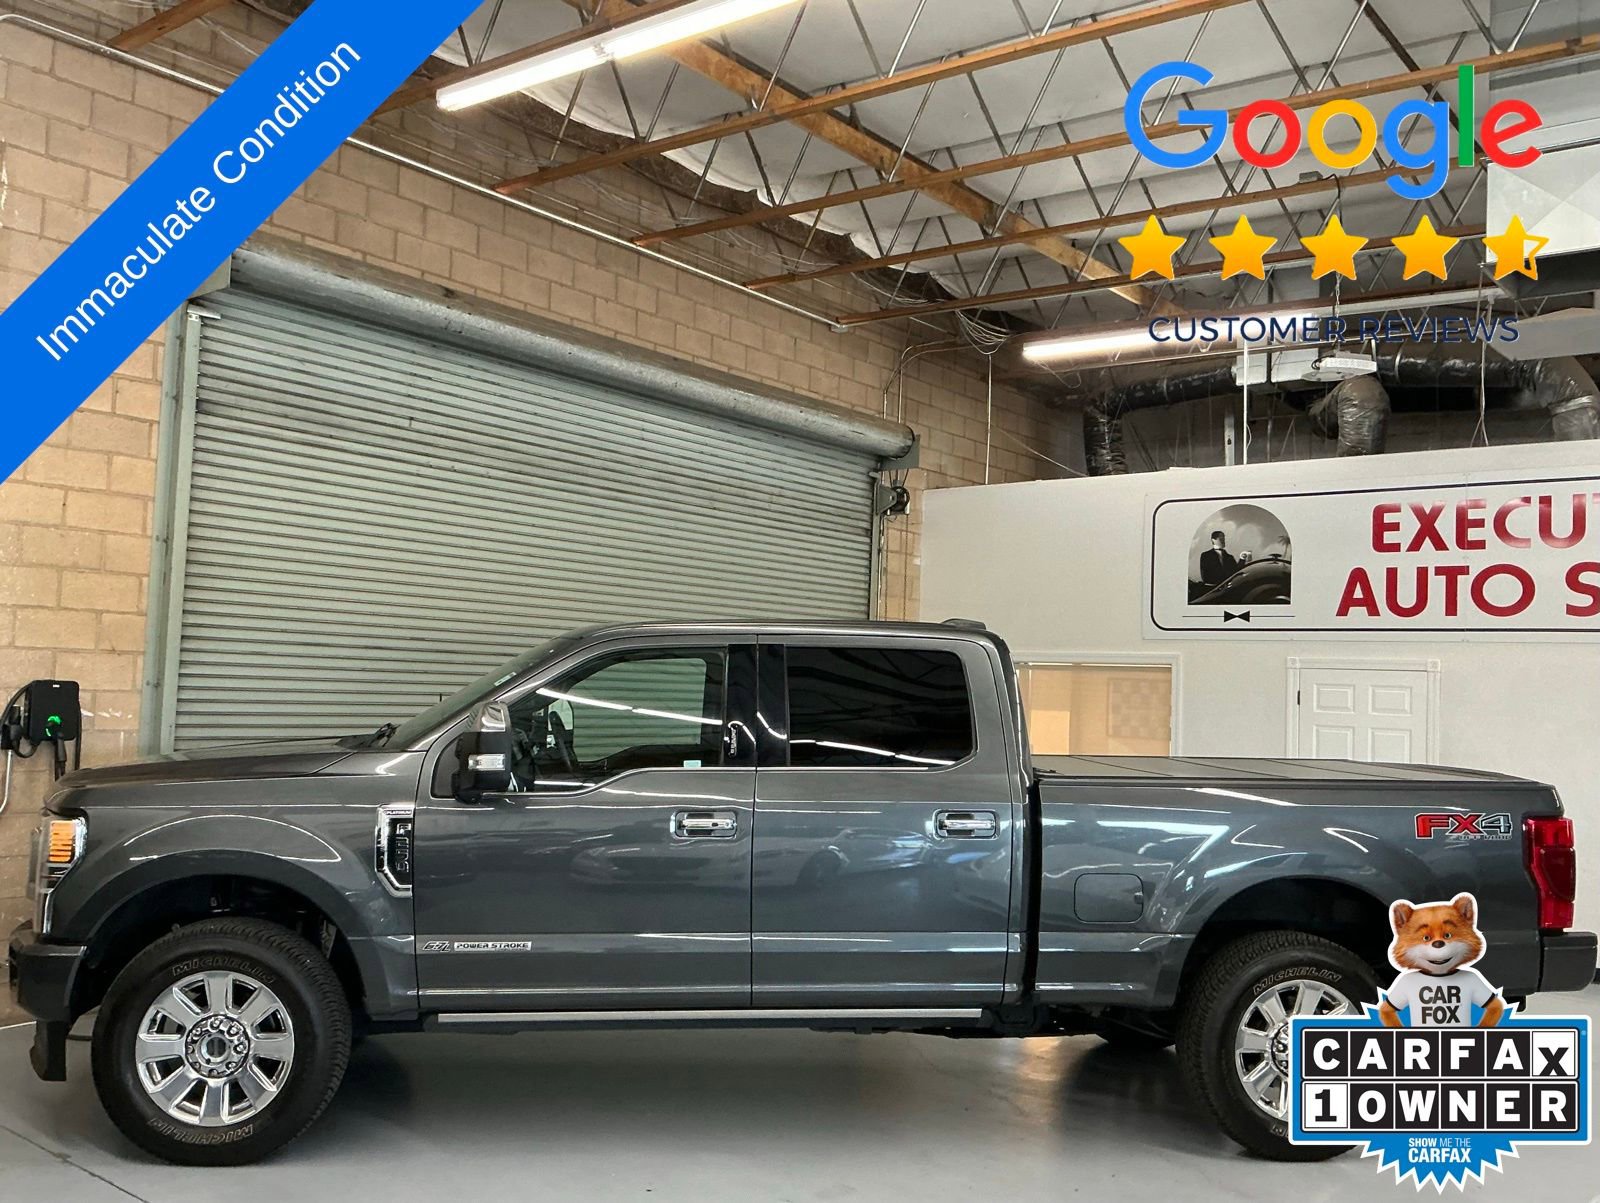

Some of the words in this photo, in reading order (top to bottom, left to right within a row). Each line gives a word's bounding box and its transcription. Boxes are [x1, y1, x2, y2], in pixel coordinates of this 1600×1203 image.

[1372, 493, 1600, 553] EXECU
[1336, 562, 1536, 618] AUTO
[1414, 813, 1513, 839] FX4
[456, 942, 489, 950] POWER
[491, 942, 529, 950] STROKE
[172, 956, 275, 984] MICHELIN
[1252, 966, 1342, 996] MICHELIN
